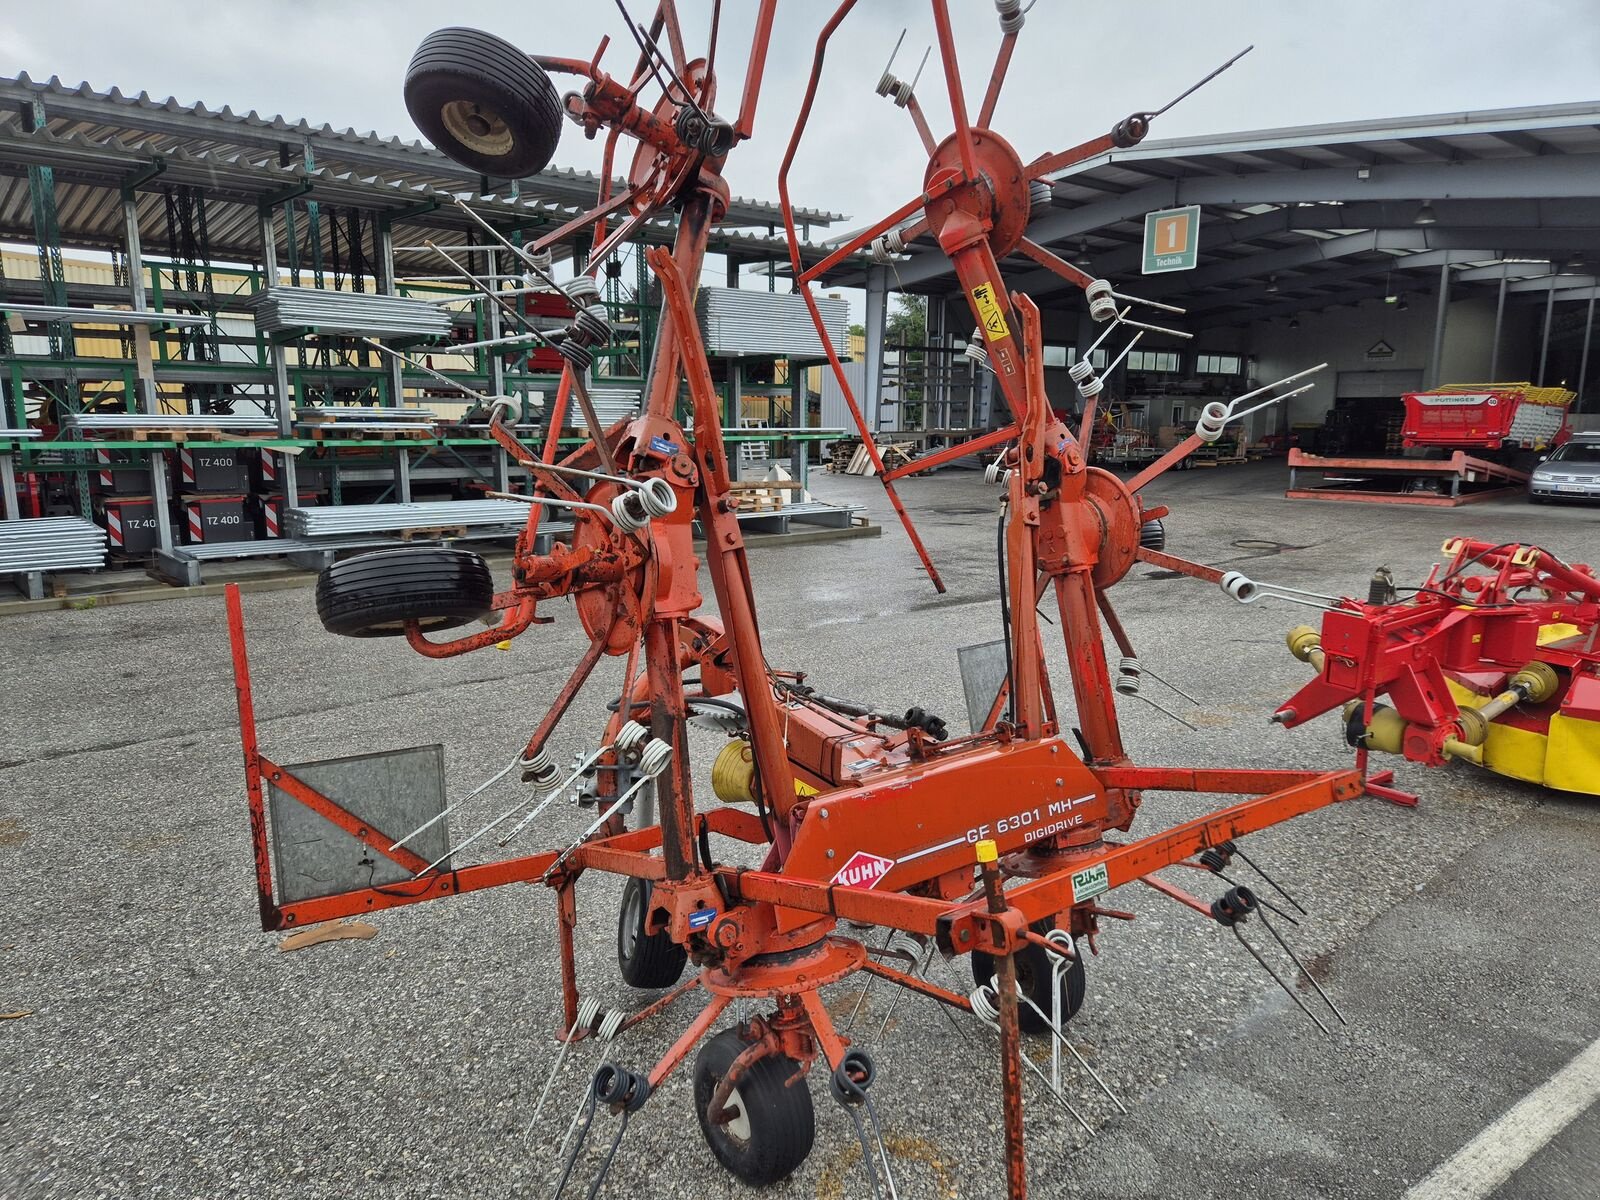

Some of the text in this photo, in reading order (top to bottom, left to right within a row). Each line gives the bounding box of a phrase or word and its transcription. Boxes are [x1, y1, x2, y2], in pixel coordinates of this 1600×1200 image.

[1167, 222, 1177, 248] 1
[1156, 256, 1183, 267] Technik
[199, 458, 233, 467] TZ 400
[127, 519, 156, 529] TZ 40
[207, 515, 240, 526] TZ 400
[966, 798, 1072, 843] GF 6301 MH
[1024, 814, 1083, 843] DIGIDRIVE
[837, 859, 886, 887] KUHN
[1072, 869, 1106, 889] Rihm
